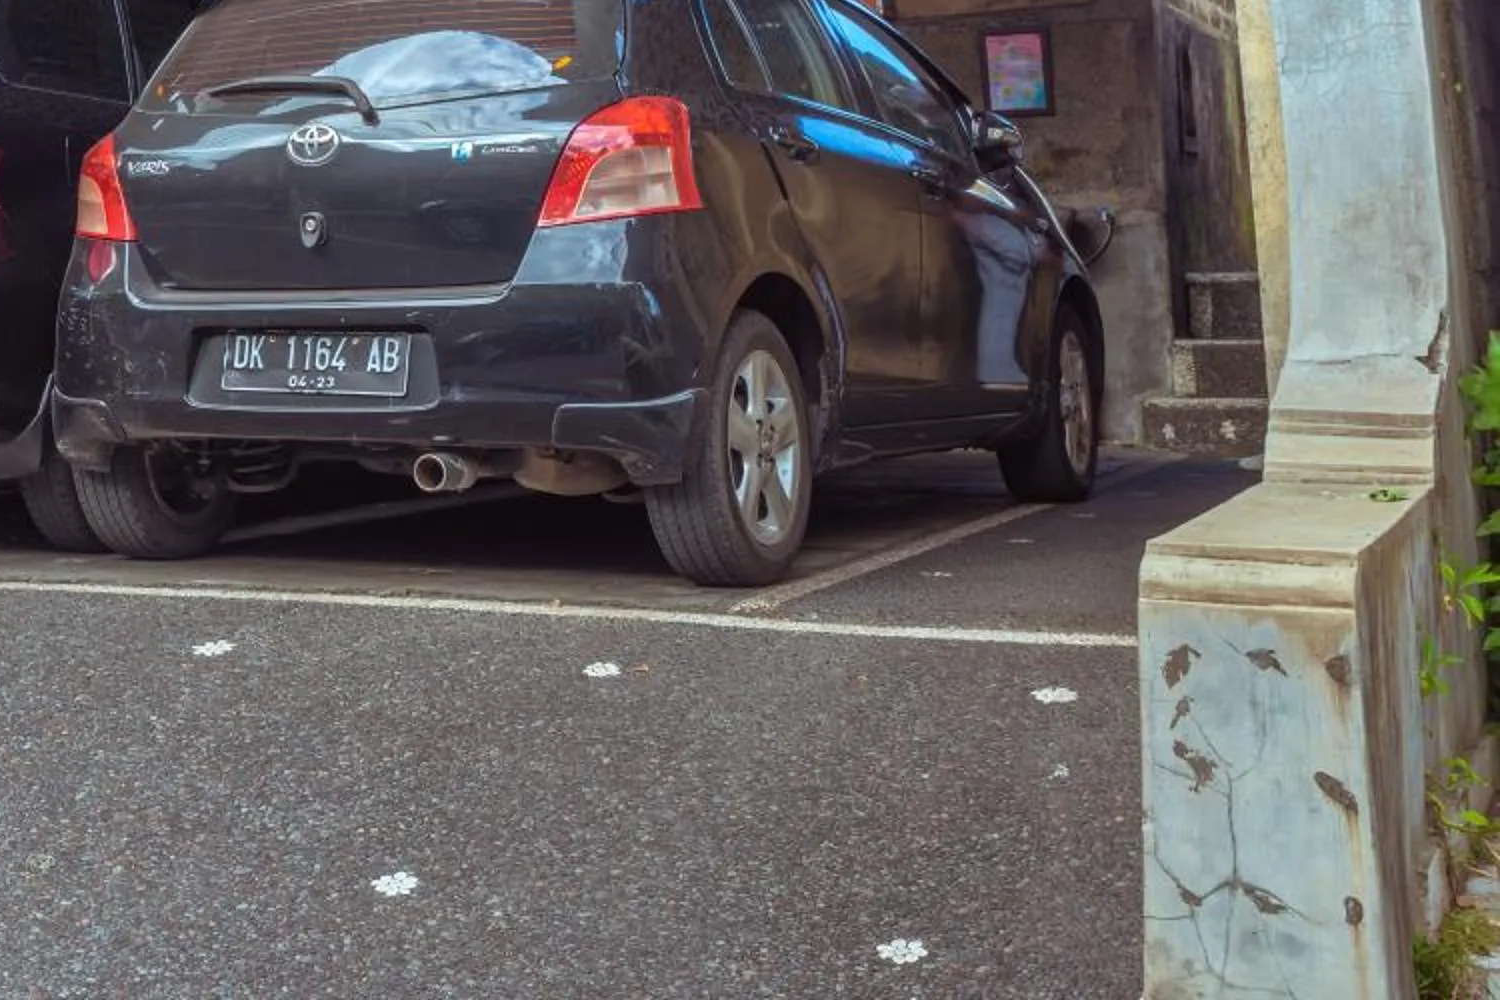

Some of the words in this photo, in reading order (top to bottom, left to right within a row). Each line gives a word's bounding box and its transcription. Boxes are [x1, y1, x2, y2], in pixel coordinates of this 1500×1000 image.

[233, 334, 266, 370] DK
[286, 335, 348, 372] 1164
[366, 337, 400, 373] AB
